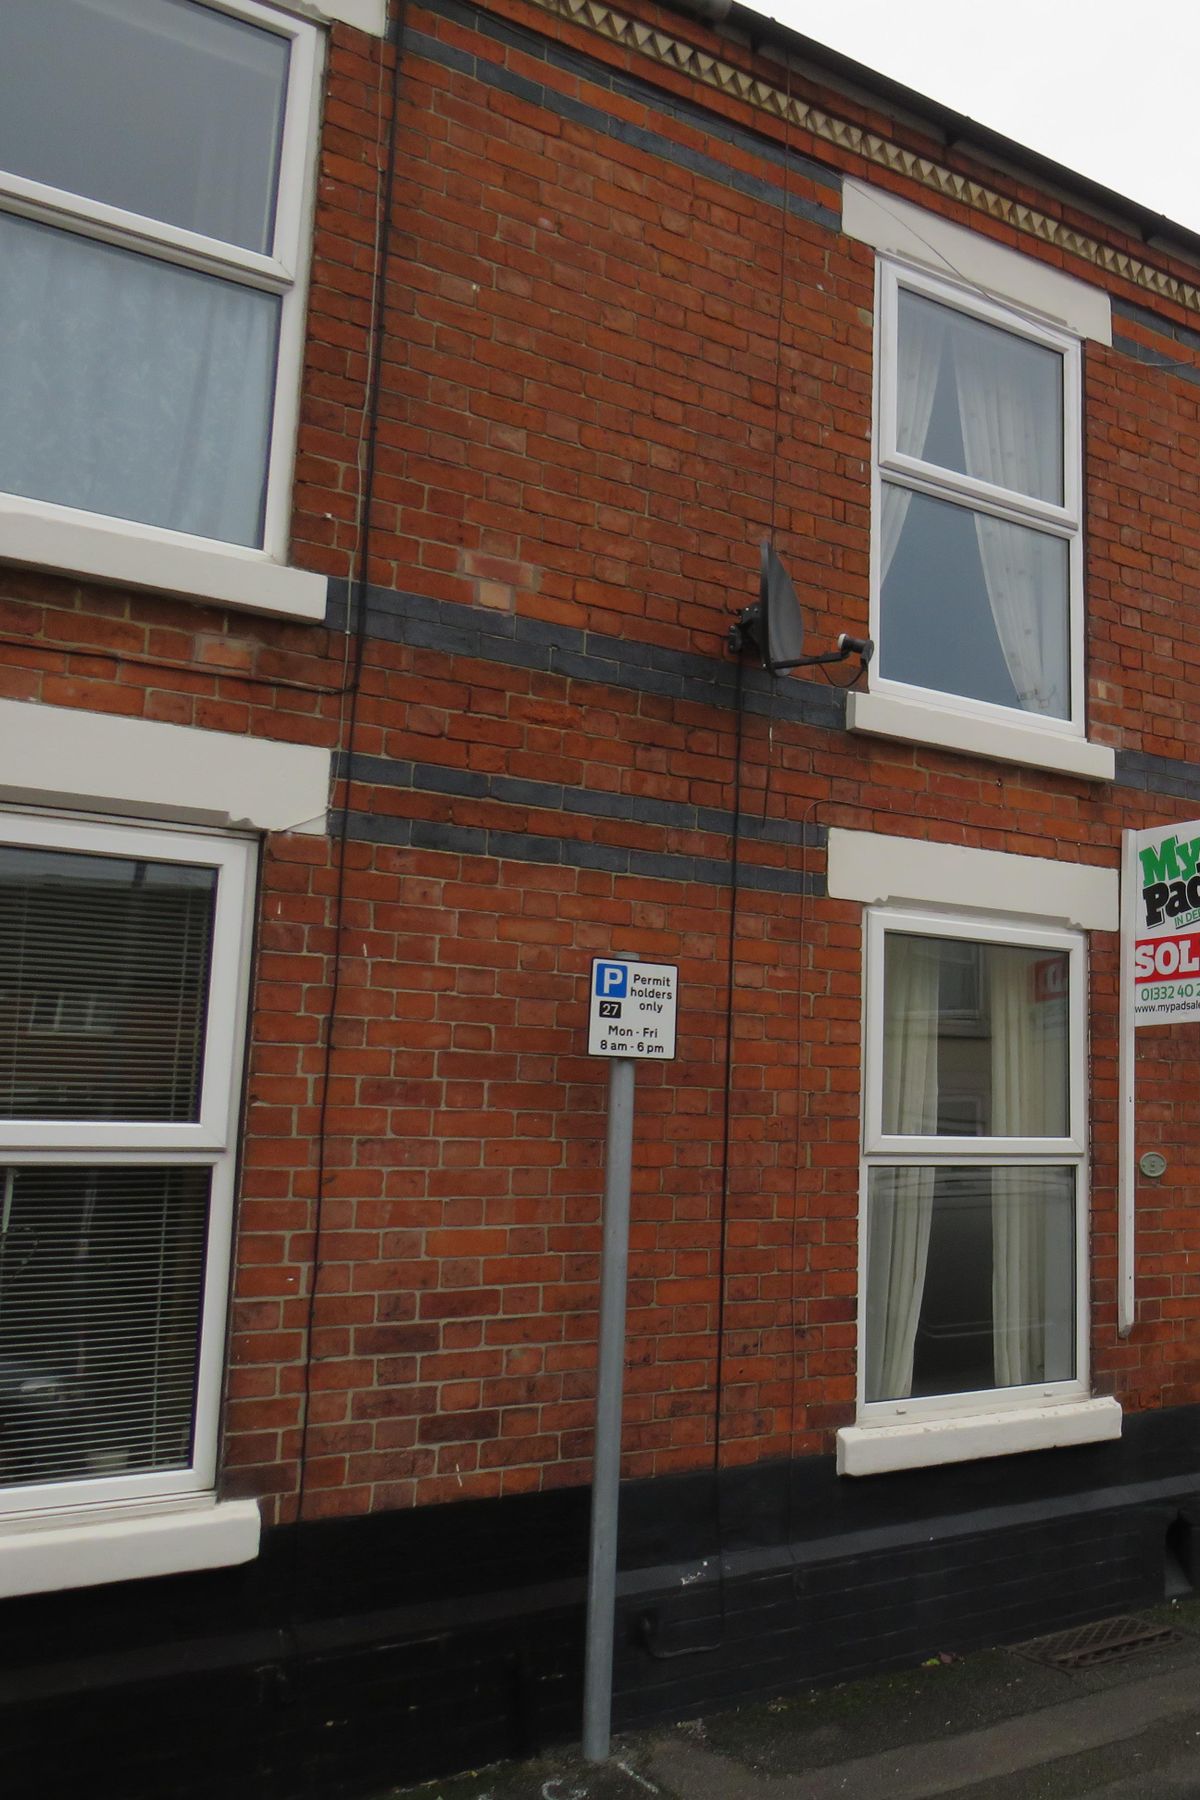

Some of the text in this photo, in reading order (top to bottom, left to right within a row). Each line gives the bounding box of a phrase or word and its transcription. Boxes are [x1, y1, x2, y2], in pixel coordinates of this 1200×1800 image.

[1173, 916, 1184, 927] IN
[603, 967, 624, 994] P
[633, 973, 671, 987] Permit
[630, 987, 673, 1000] holders
[1141, 985, 1175, 1001] 01332
[1177, 984, 1194, 998] 40
[602, 1003, 619, 1016] 27
[639, 1001, 663, 1013] only
[608, 1025, 633, 1037] Mon
[642, 1027, 658, 1038] Fri
[600, 1040, 607, 1050] 8
[610, 1042, 628, 1051] am
[637, 1041, 644, 1052] 6
[646, 1044, 664, 1054] pm
